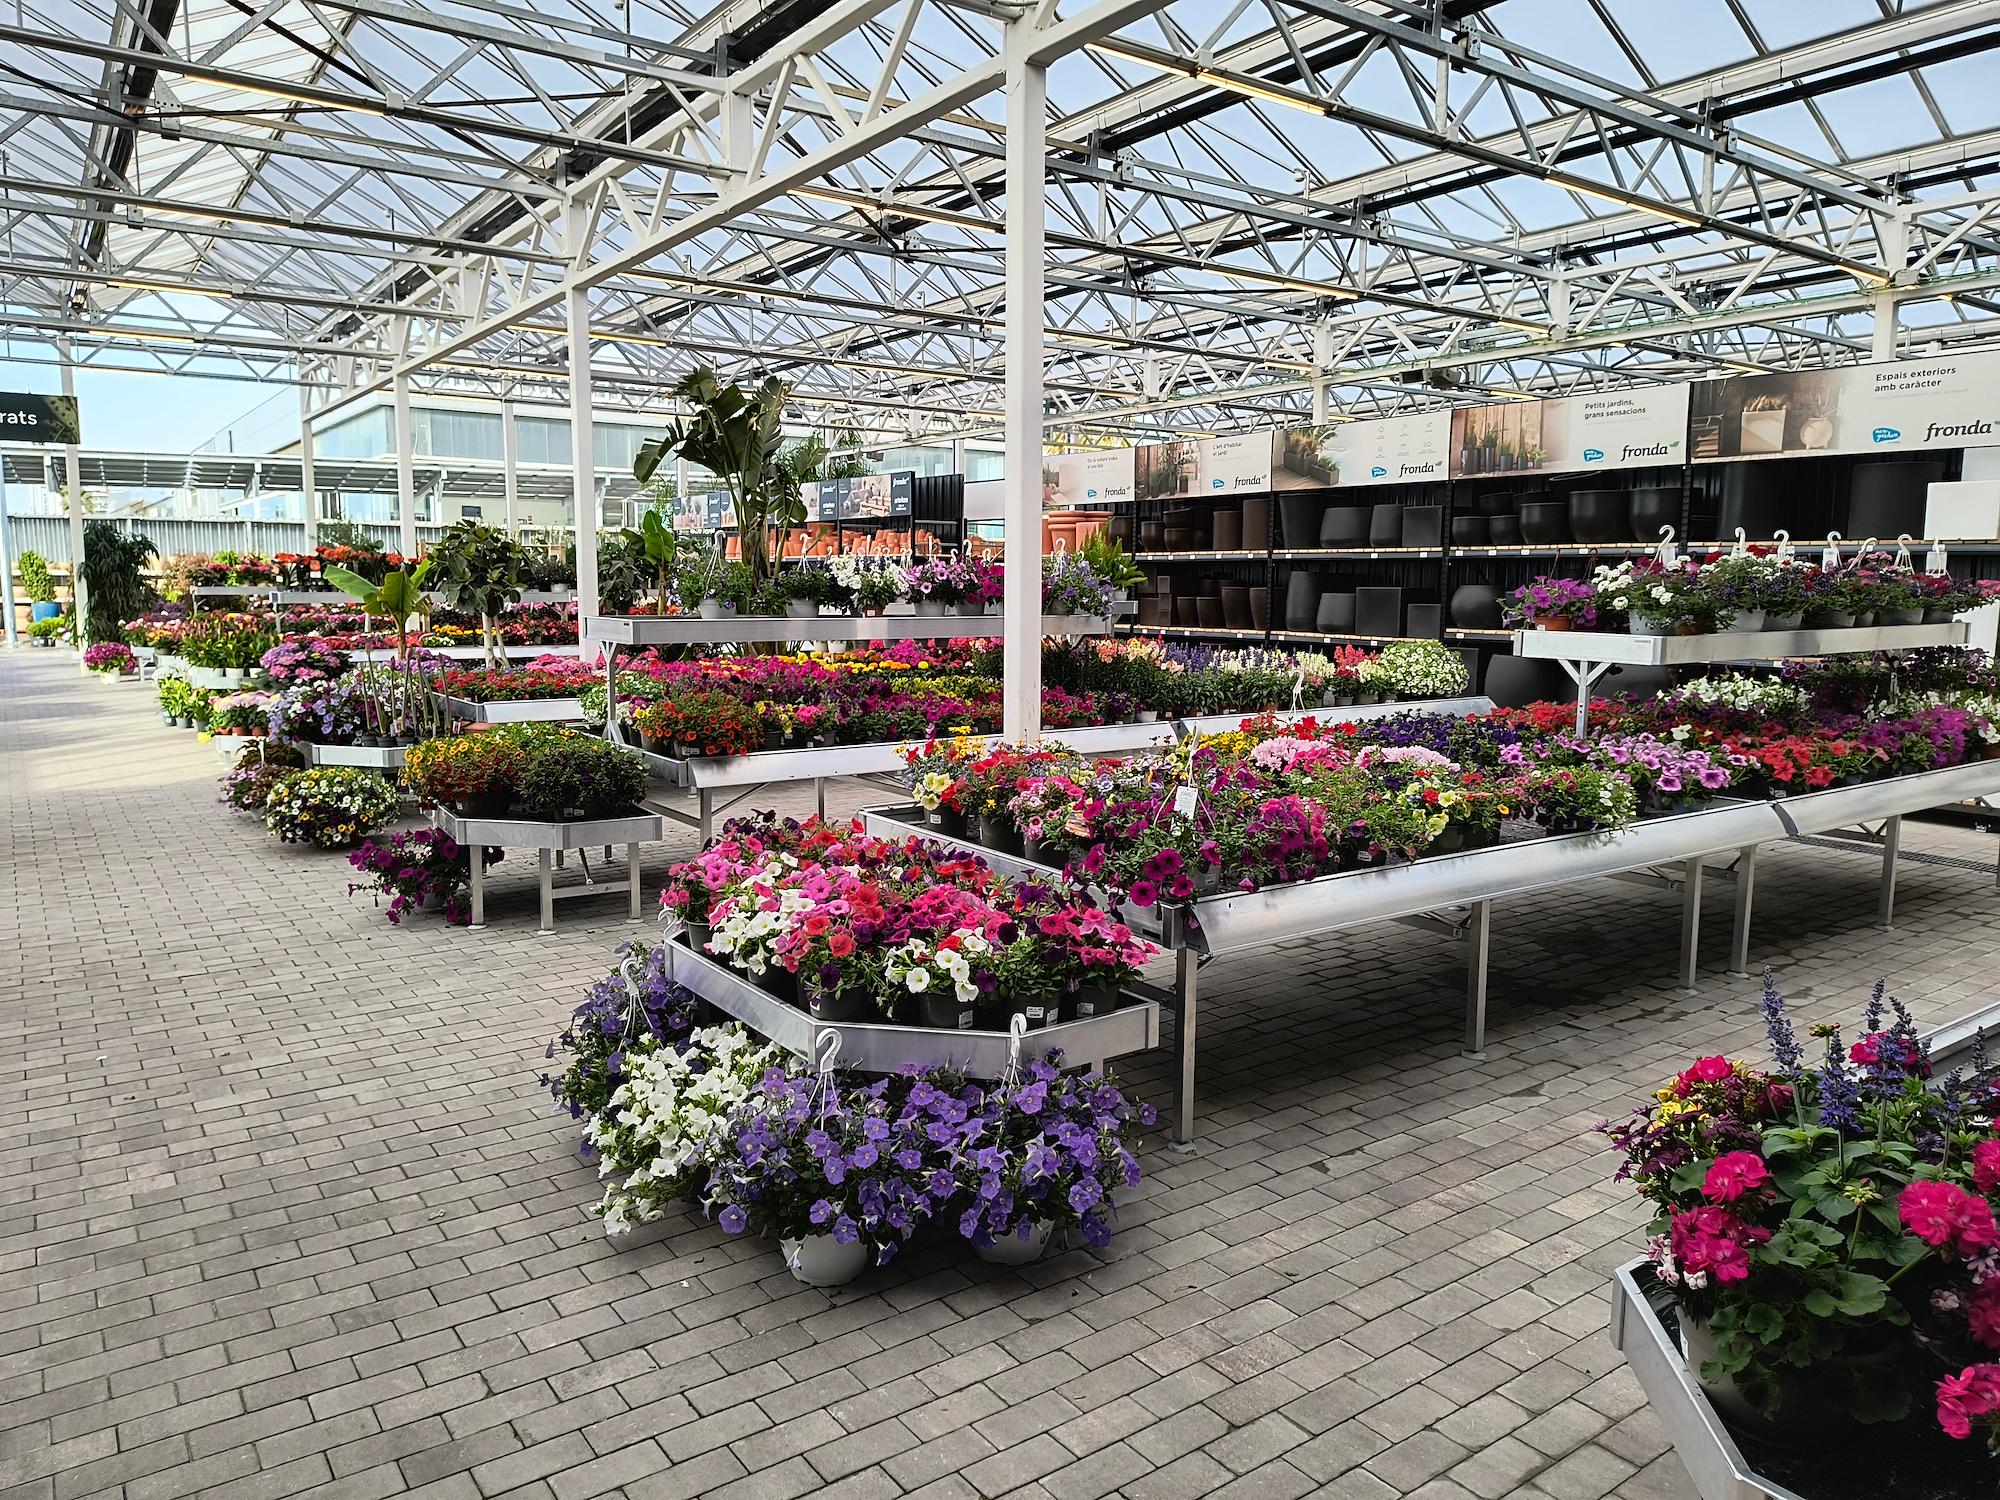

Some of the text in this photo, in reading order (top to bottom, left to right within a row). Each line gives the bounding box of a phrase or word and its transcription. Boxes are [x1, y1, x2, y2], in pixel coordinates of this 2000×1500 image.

[1876, 367, 1956, 381] Espais exteriors
[1874, 380, 1942, 392] amb caràcter
[1607, 399, 1634, 408] jardins,
[1584, 407, 1646, 420] grans sensacions
[1923, 419, 1992, 442] fronda
[1620, 443, 1669, 461] fronda
[1399, 462, 1435, 478] fronda
[1234, 476, 1262, 489] fronda
[1104, 486, 1126, 498] fronda
